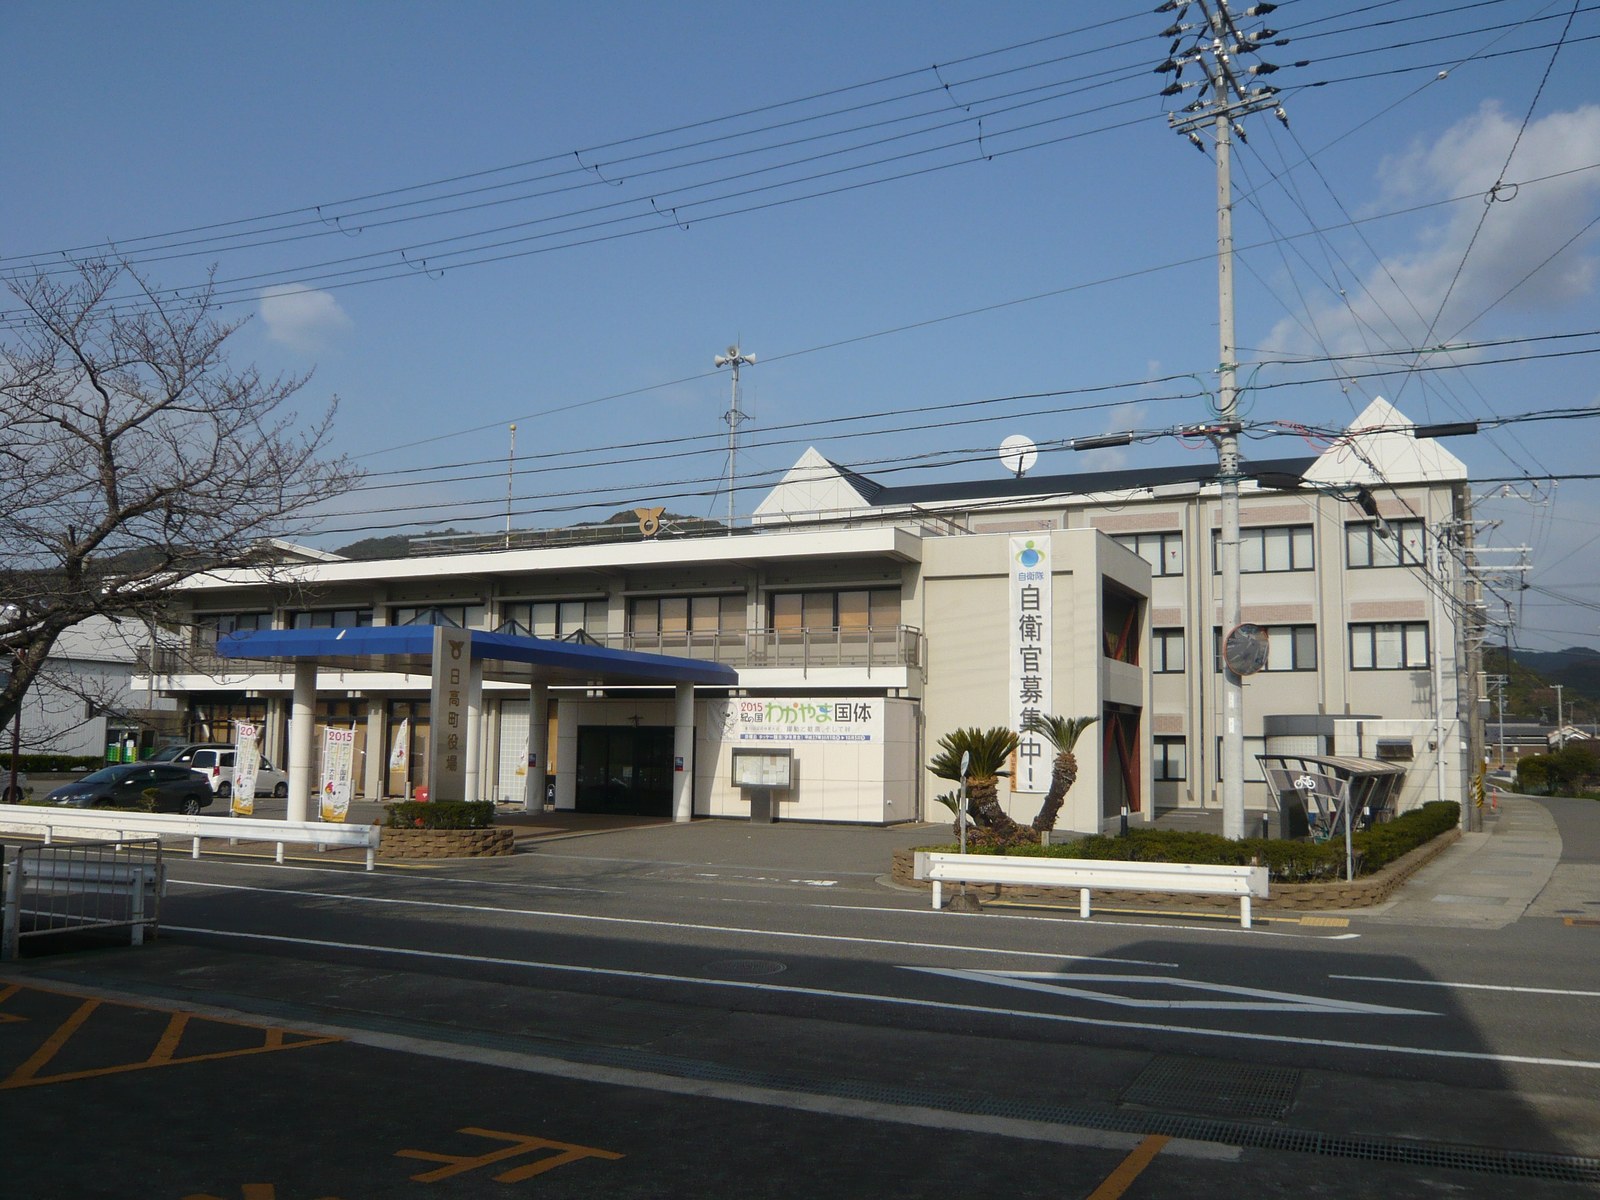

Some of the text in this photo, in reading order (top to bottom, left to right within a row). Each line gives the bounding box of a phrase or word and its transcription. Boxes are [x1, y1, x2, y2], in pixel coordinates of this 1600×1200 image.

[1018, 572, 1044, 581] 自衛隊
[740, 702, 763, 712] 2015
[446, 668, 460, 772] 日高町役場
[740, 713, 763, 722] 紀の国
[329, 731, 352, 741] 2015
